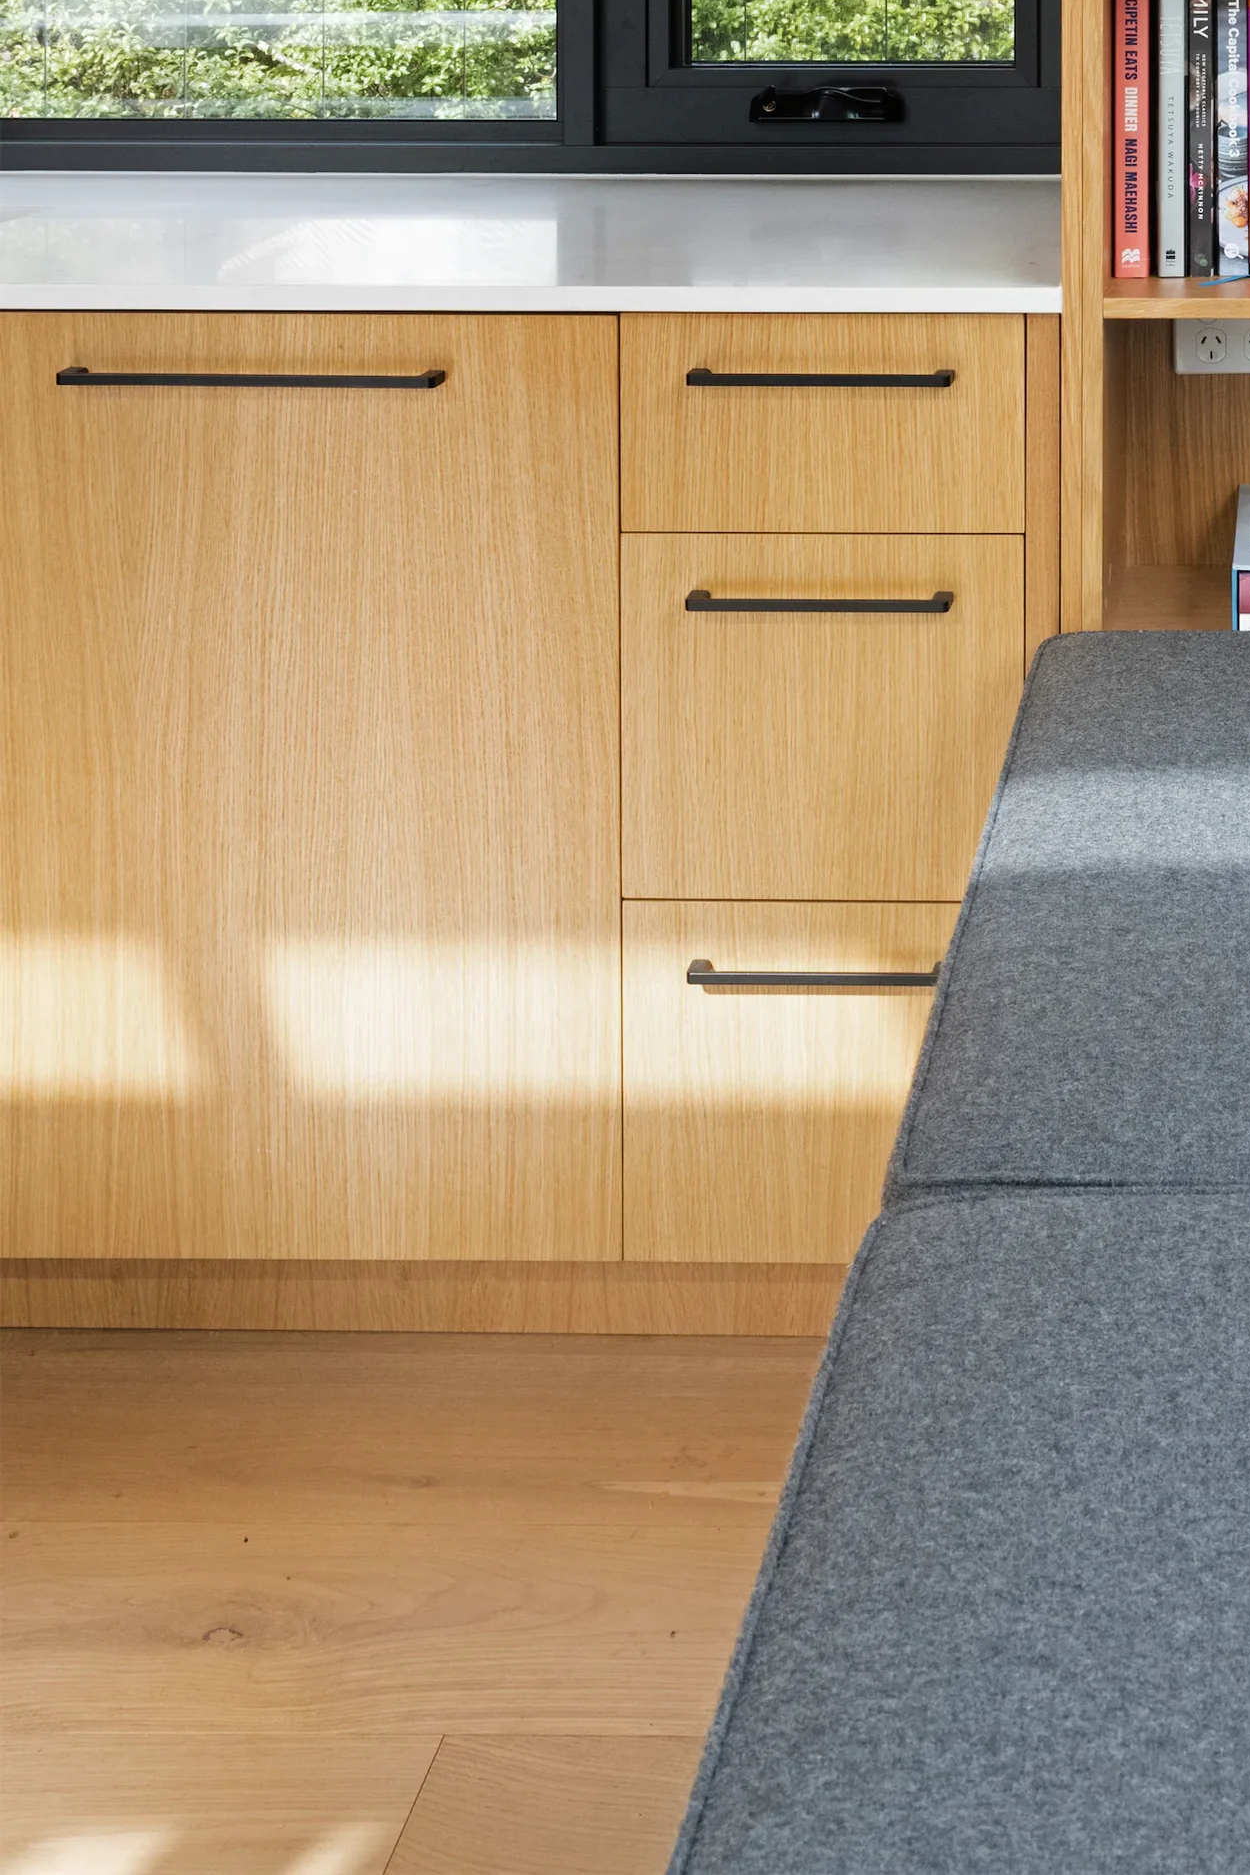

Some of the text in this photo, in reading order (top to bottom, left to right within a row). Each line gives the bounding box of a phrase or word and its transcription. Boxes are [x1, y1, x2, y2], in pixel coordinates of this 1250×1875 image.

[1228, 0, 1239, 27] The
[1124, 50, 1138, 80] EATS
[1124, 87, 1138, 132] DINNER
[1124, 139, 1138, 167] NAGI
[1124, 172, 1138, 233] MAEHASHI
